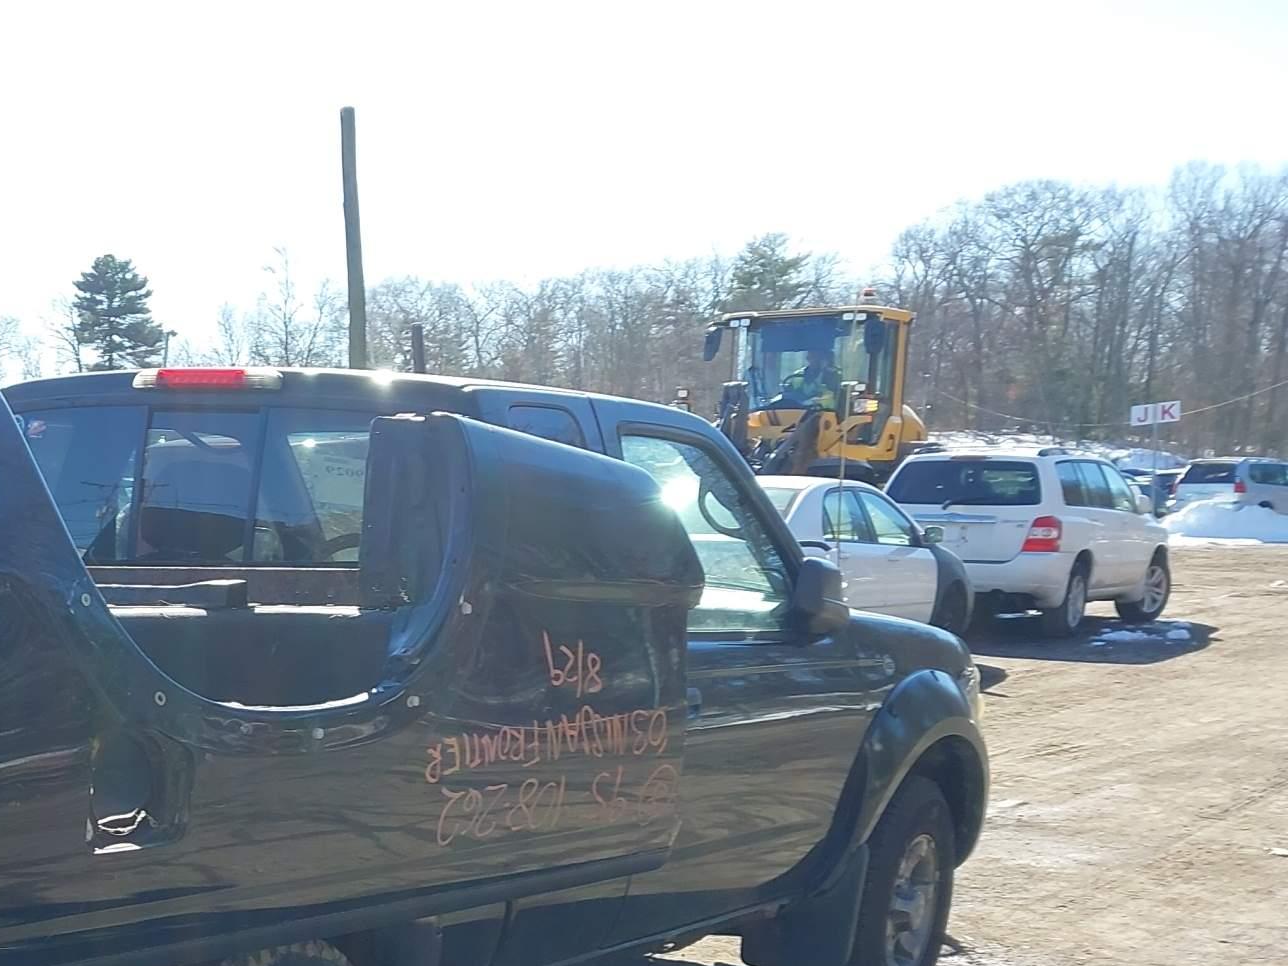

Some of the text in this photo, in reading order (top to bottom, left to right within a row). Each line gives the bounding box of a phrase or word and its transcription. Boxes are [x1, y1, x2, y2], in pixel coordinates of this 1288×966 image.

[1137, 403, 1176, 423] J K
[425, 719, 541, 784] FRONTIER
